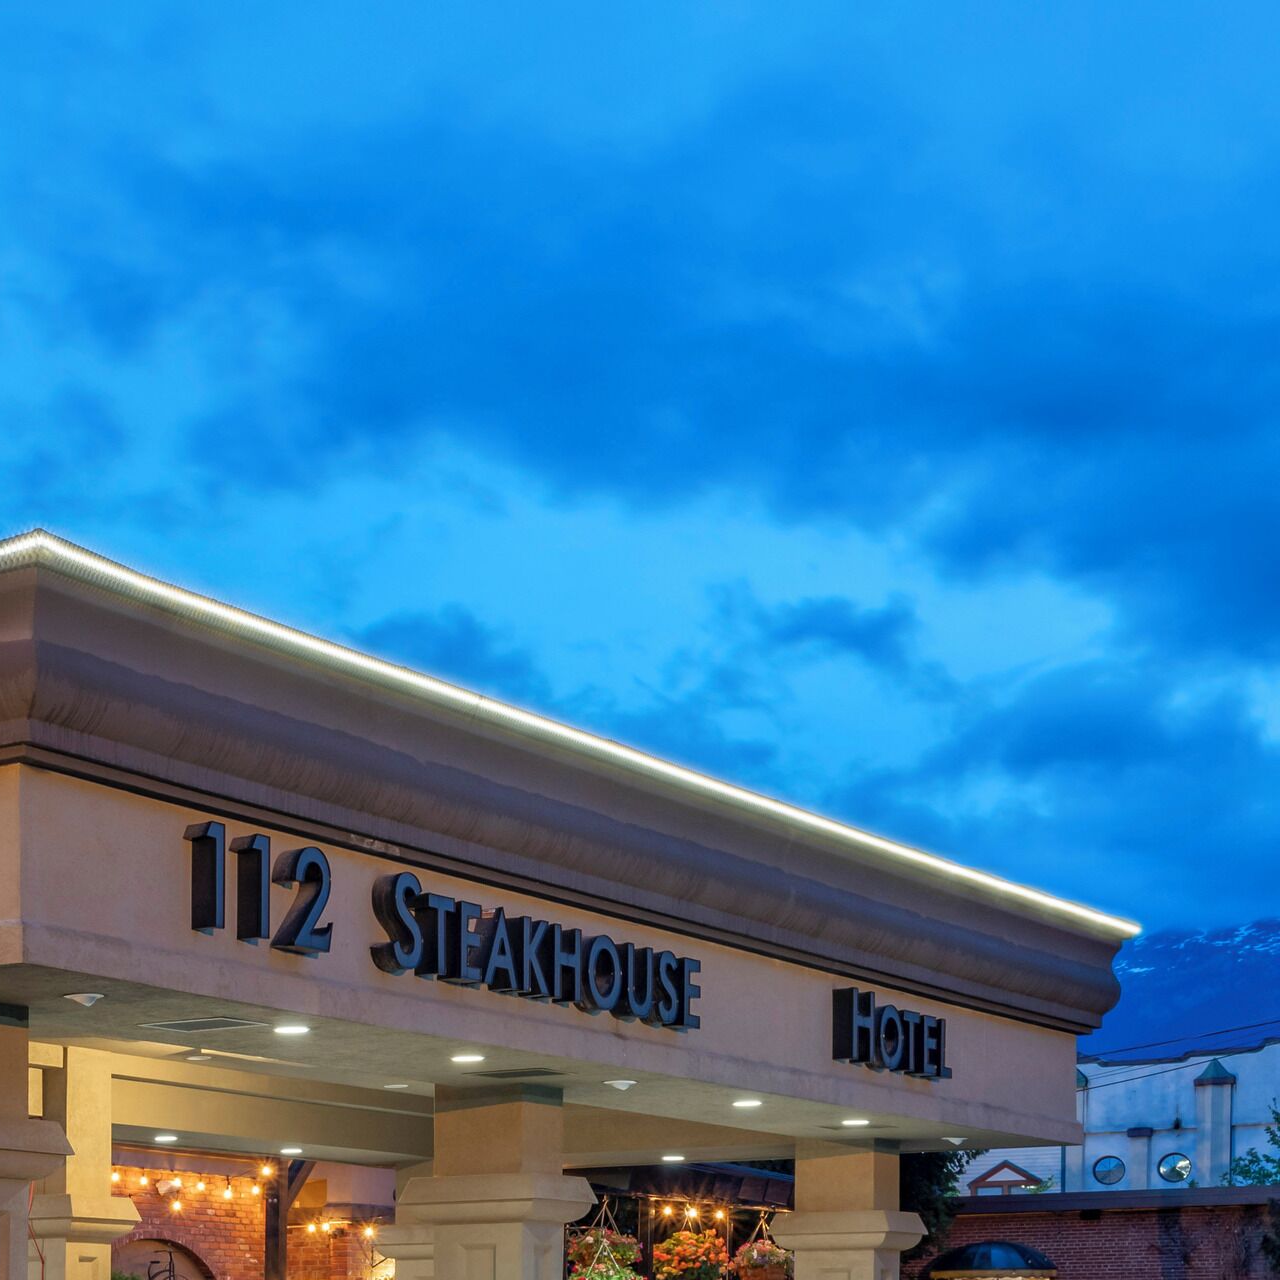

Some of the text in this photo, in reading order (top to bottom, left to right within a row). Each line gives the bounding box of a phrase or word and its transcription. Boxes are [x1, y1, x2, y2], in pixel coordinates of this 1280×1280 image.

[183, 820, 702, 1031] 112 STEAKHOUSE
[832, 986, 953, 1080] HOTEL
